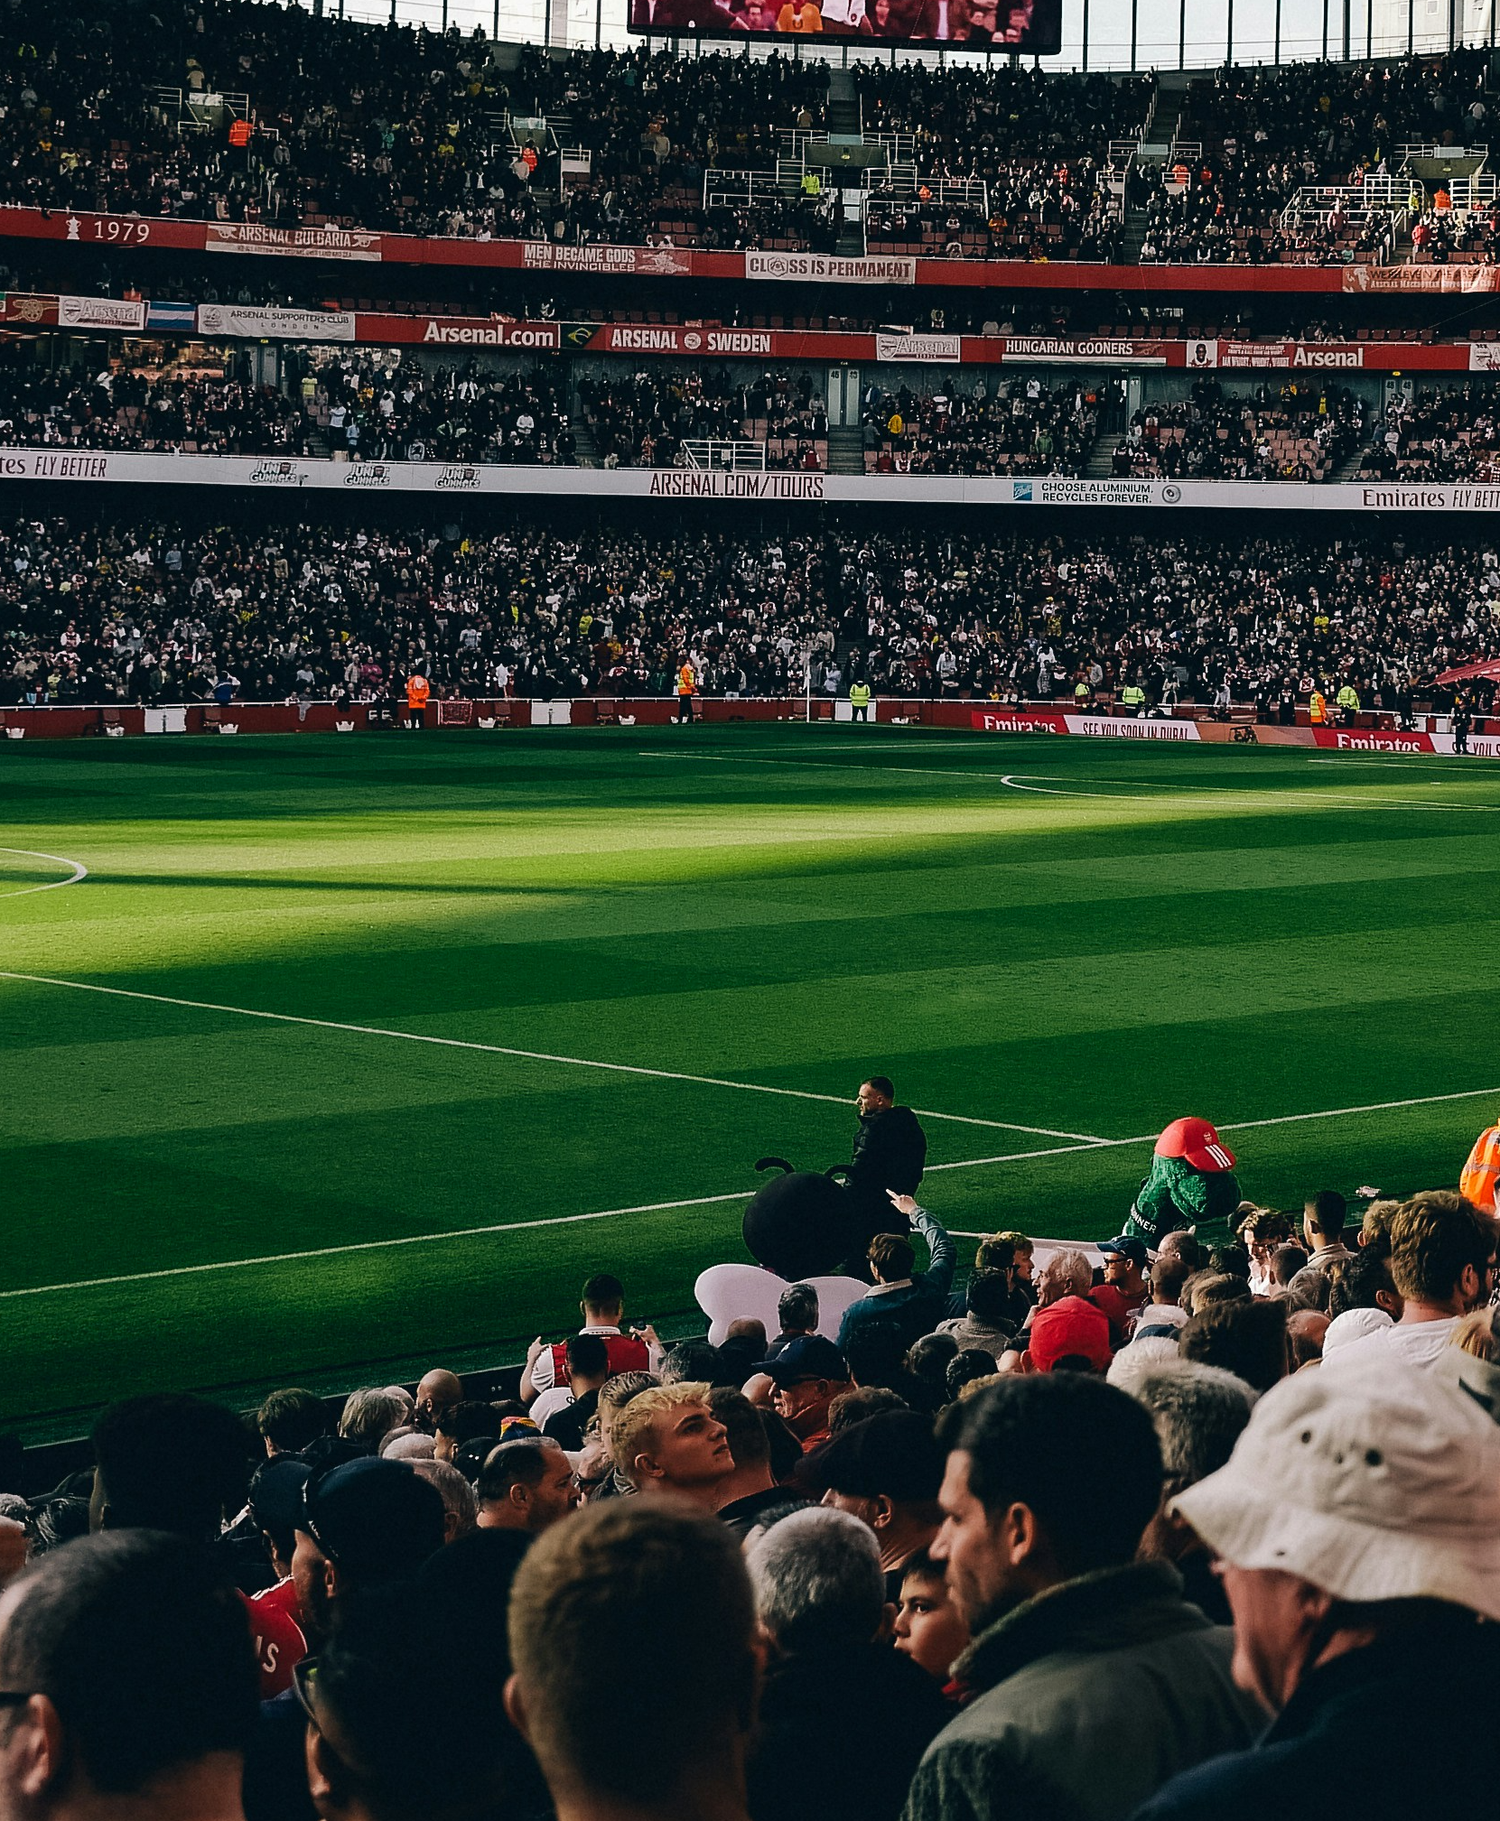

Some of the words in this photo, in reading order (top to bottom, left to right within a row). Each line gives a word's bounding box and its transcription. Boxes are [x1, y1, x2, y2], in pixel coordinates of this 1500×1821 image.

[94, 220, 150, 243] 1979
[238, 226, 292, 245] ARSENAL
[294, 230, 351, 247] BULGARIA
[524, 244, 552, 260] MEN
[555, 246, 603, 263] BECAME
[605, 248, 636, 264] GODS
[524, 259, 551, 269] THE
[553, 260, 636, 272] INVINCIBLES
[811, 259, 825, 275] IS
[828, 261, 911, 278] PERMANENT
[80, 300, 141, 321] Arsenal
[230, 310, 270, 320] ARSENAL
[272, 312, 326, 323] SUPPORTERS
[327, 314, 350, 324] CLUB
[260, 322, 320, 330] LONDON
[423, 320, 554, 347] Arsenal.com
[611, 328, 678, 350] ARSENAL
[707, 331, 771, 352] SWEDEN
[898, 337, 958, 353] Arsenal
[1006, 340, 1074, 354] HUNGARIAN
[1077, 342, 1134, 355] GOONERS
[1293, 347, 1364, 367] Arsenal
[35, 456, 57, 476] FLY
[60, 457, 108, 478] BETTER
[650, 473, 824, 498] ARSENAL.COM/TOURS
[1041, 483, 1086, 493] CHOOSE
[1089, 483, 1153, 494] ALUMINIUM.
[1042, 493, 1098, 502] RECYCLES
[1100, 494, 1152, 503] FOREVER.
[1363, 488, 1445, 507] Emirates
[1452, 488, 1473, 508] FLY
[983, 715, 1057, 733] Emirates
[1336, 733, 1421, 752] Emirates
